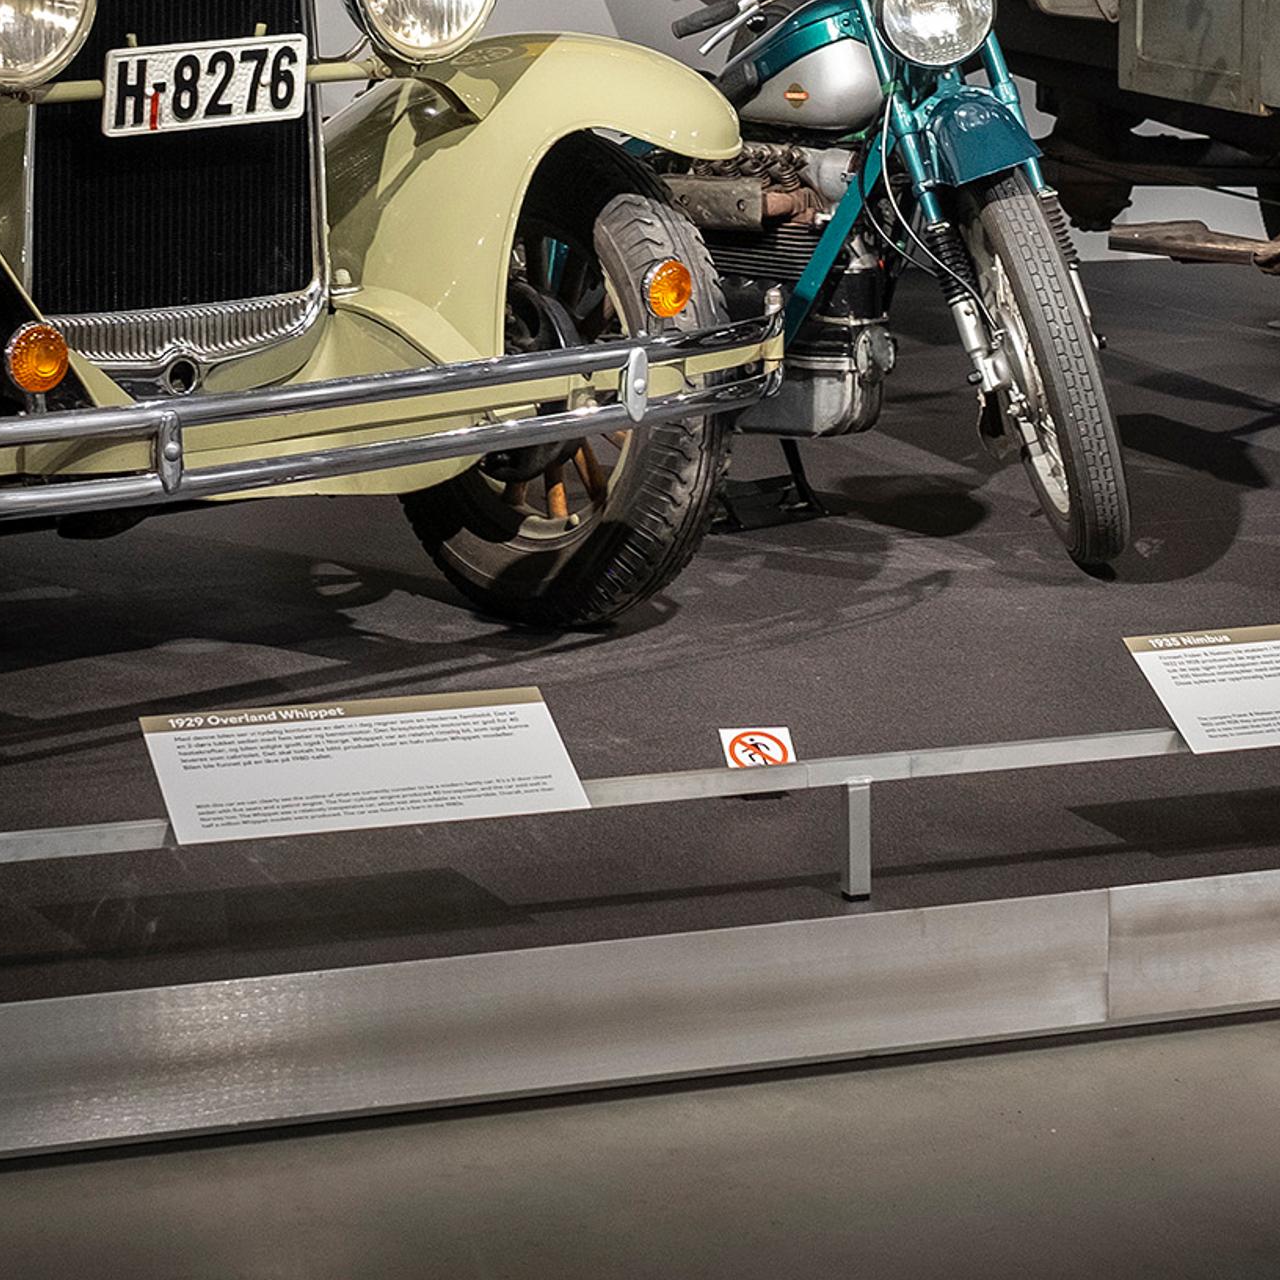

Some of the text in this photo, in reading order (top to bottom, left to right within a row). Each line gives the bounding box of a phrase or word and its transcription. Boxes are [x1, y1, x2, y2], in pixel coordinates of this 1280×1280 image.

[114, 46, 298, 128] H-8276
[1180, 633, 1231, 646] Nimbus
[167, 705, 345, 729] 1929 Overland Whippet
